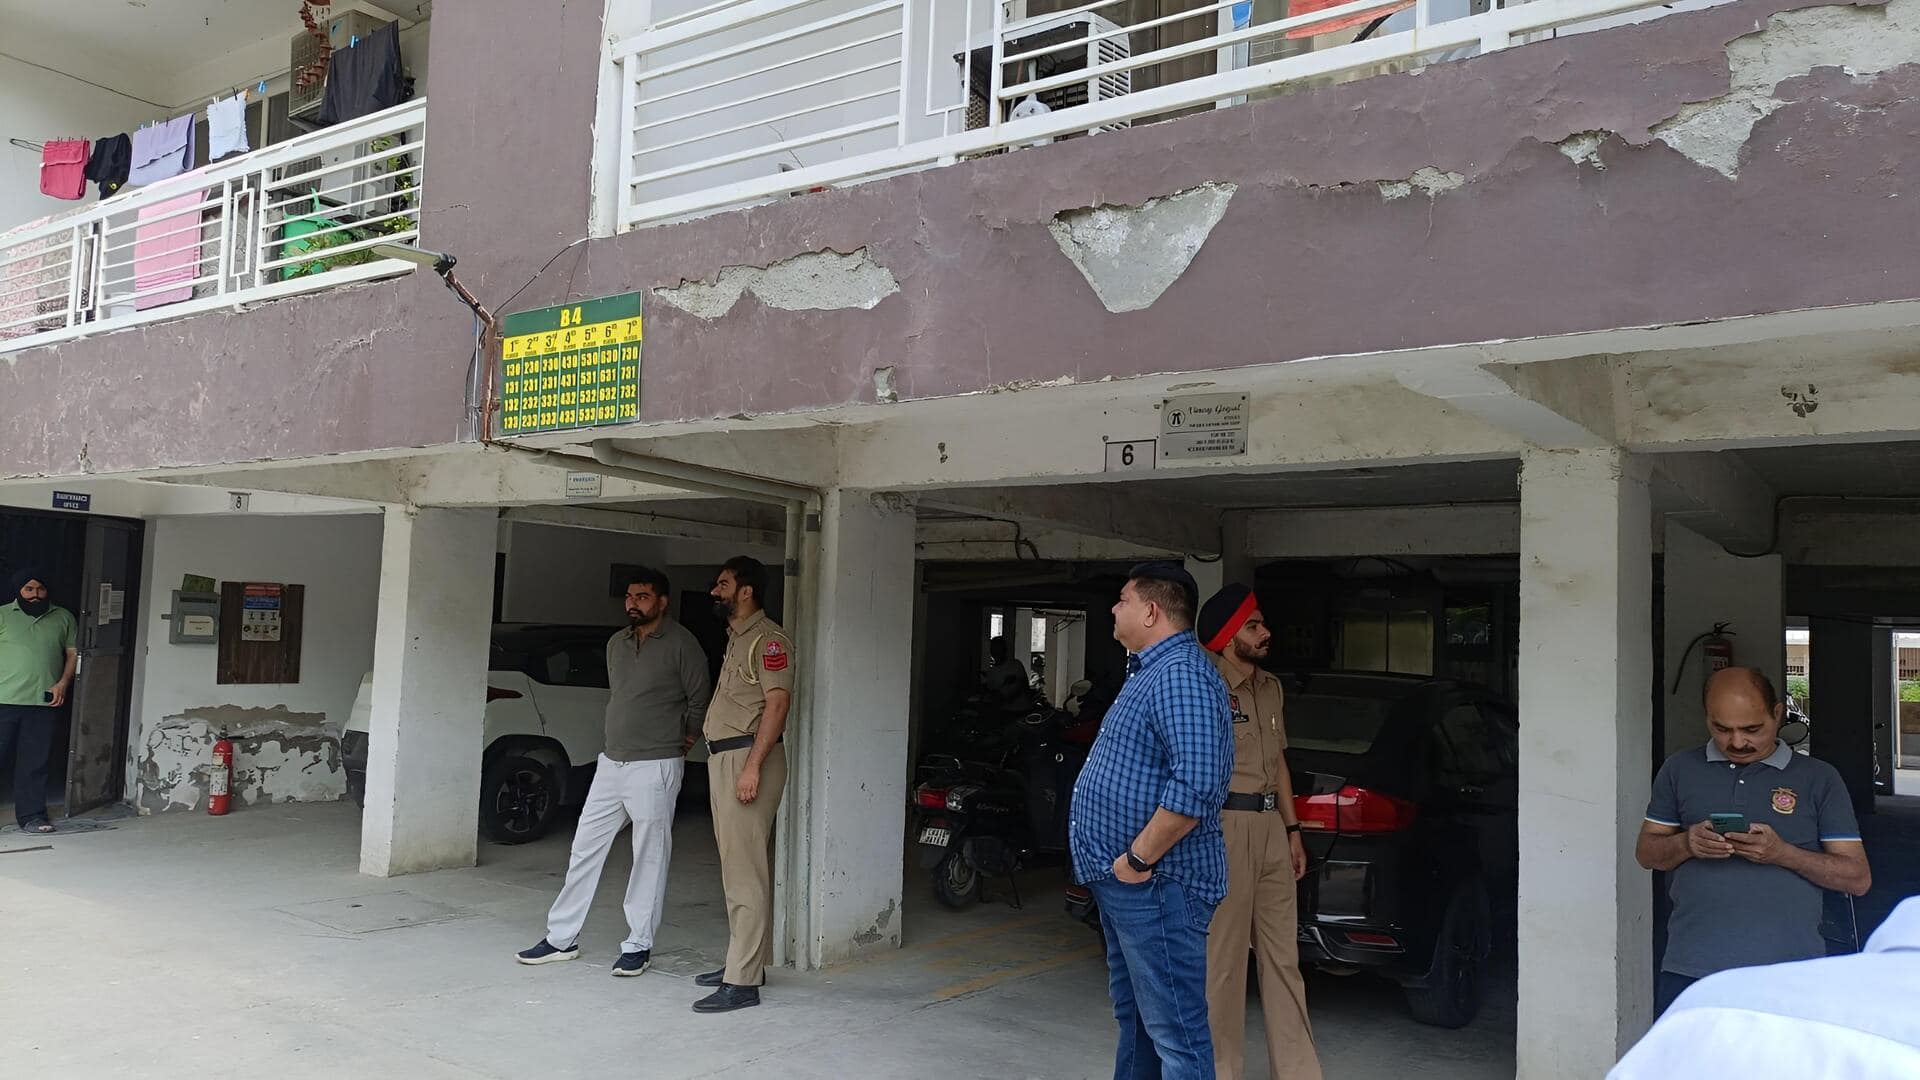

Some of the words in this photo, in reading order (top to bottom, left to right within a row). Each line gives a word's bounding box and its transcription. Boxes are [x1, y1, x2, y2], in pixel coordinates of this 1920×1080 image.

[561, 307, 581, 326] B4
[525, 361, 539, 374] 230
[562, 355, 577, 368] 430
[581, 352, 598, 366] 530
[622, 347, 638, 360] 730
[506, 382, 518, 394] 131
[524, 380, 538, 392] 231
[561, 374, 576, 386] 431
[581, 371, 596, 384] 531
[600, 369, 616, 382] 631
[621, 366, 635, 379] 731
[505, 399, 518, 412] 132
[523, 396, 538, 409] 232
[541, 394, 557, 407] 332
[561, 392, 576, 404] 432
[580, 389, 596, 403] 532
[600, 387, 616, 400] 632
[621, 384, 636, 398] 732
[522, 414, 537, 427] 233
[560, 410, 575, 423] 433
[579, 407, 594, 421] 533
[599, 405, 615, 419] 633
[620, 403, 636, 417] 733
[1122, 444, 1134, 466] 6
